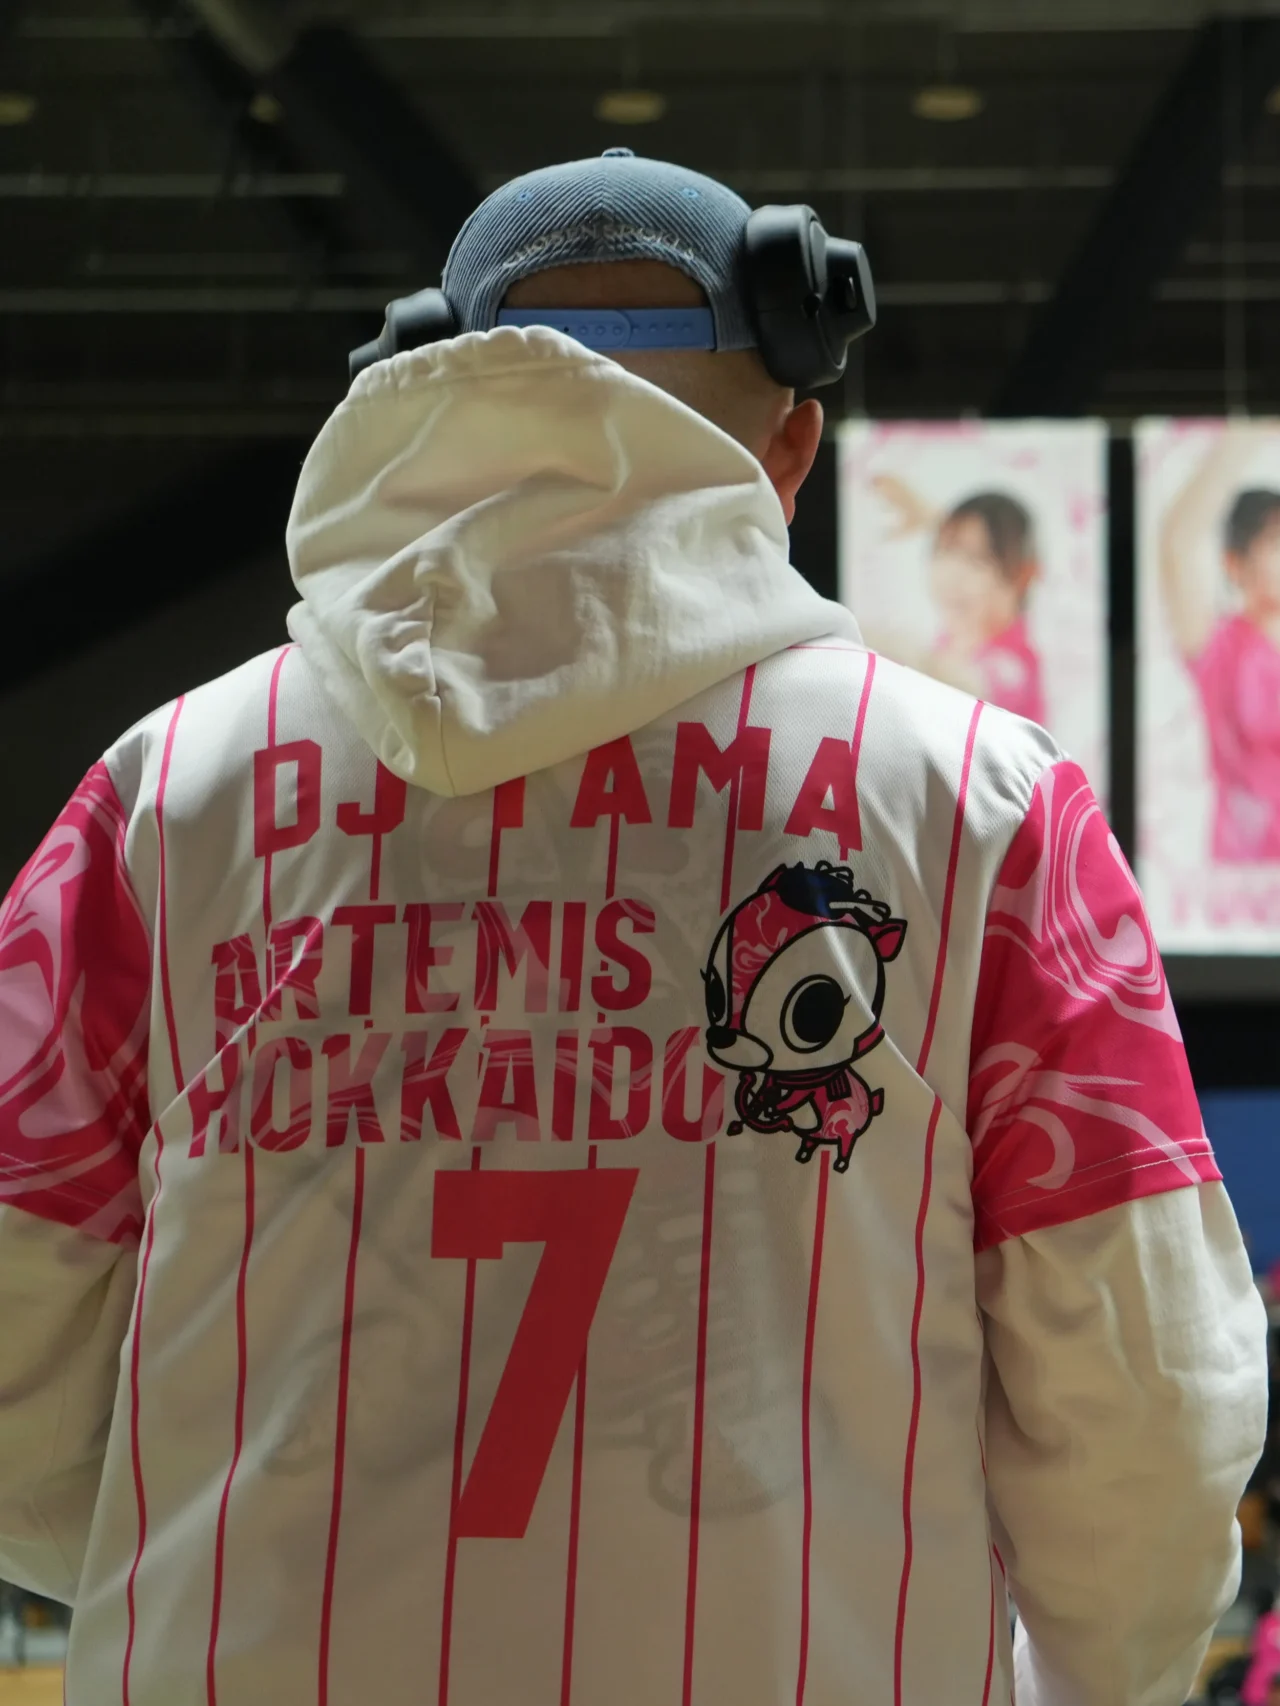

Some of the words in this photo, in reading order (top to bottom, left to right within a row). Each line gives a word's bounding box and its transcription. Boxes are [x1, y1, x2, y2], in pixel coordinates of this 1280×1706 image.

[254, 738, 407, 858] DJ
[211, 898, 656, 1053] ARTEMIS
[187, 1025, 726, 1158] HOKKAIDO
[431, 1168, 639, 1538] 7
